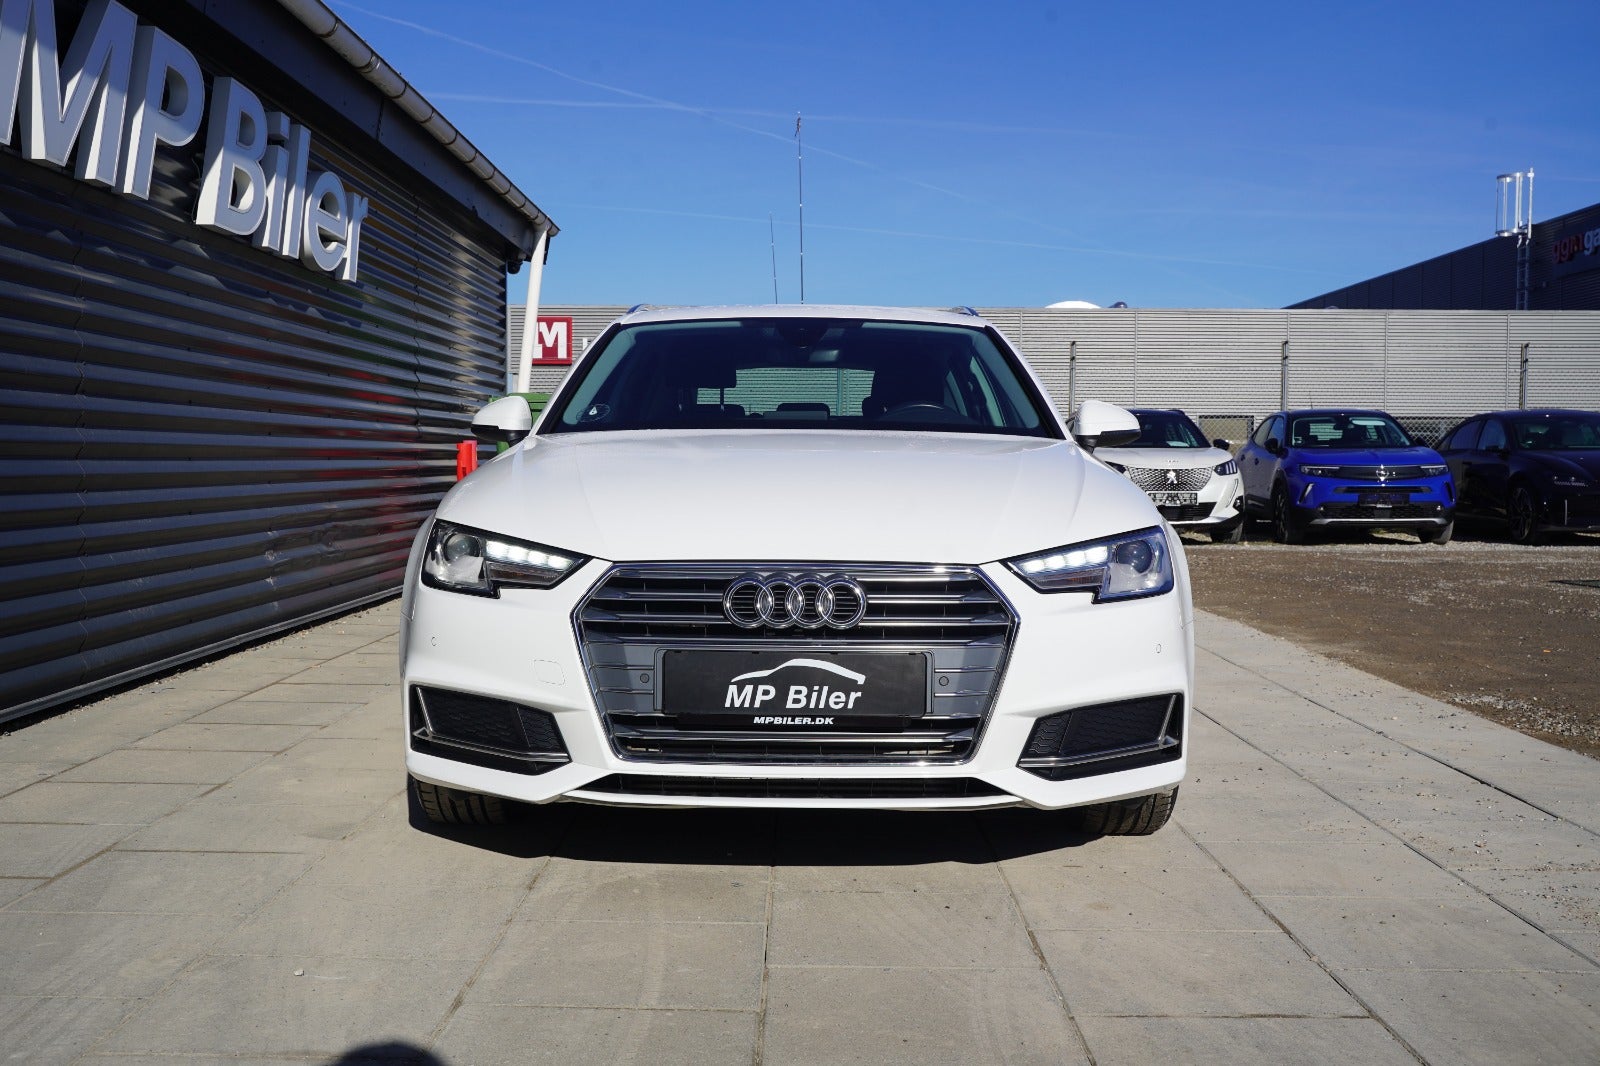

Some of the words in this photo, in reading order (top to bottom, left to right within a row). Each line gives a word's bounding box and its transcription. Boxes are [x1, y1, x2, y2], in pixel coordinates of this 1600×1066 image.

[0, 0, 206, 200] MP
[196, 77, 369, 283] Biler
[724, 684, 776, 708] MP
[785, 685, 863, 710] Biler
[753, 716, 835, 725] MPBILER.DK
